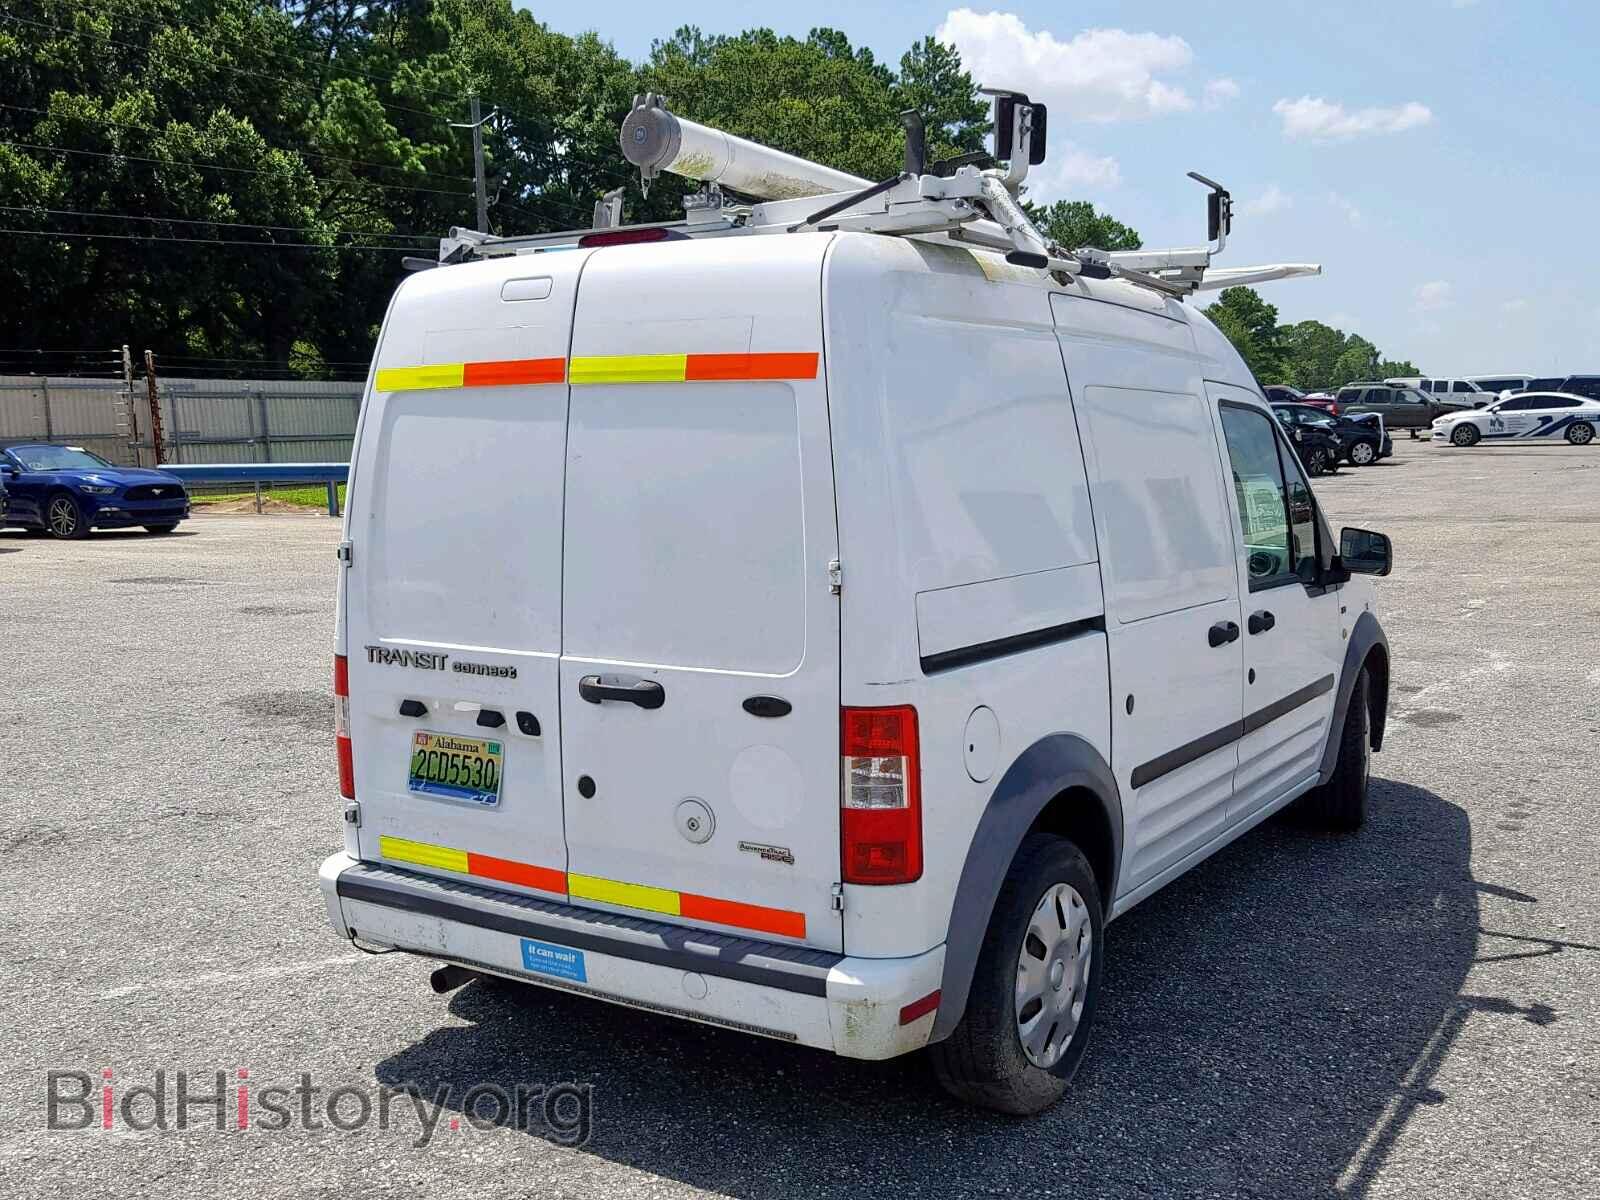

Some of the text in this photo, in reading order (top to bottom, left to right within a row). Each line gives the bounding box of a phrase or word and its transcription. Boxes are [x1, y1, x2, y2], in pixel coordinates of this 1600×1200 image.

[365, 645, 518, 680] TRANSIT connect
[434, 736, 480, 753] Alabama
[415, 748, 496, 789] 2CD5530
[536, 947, 554, 959] can
[554, 950, 576, 963] wait
